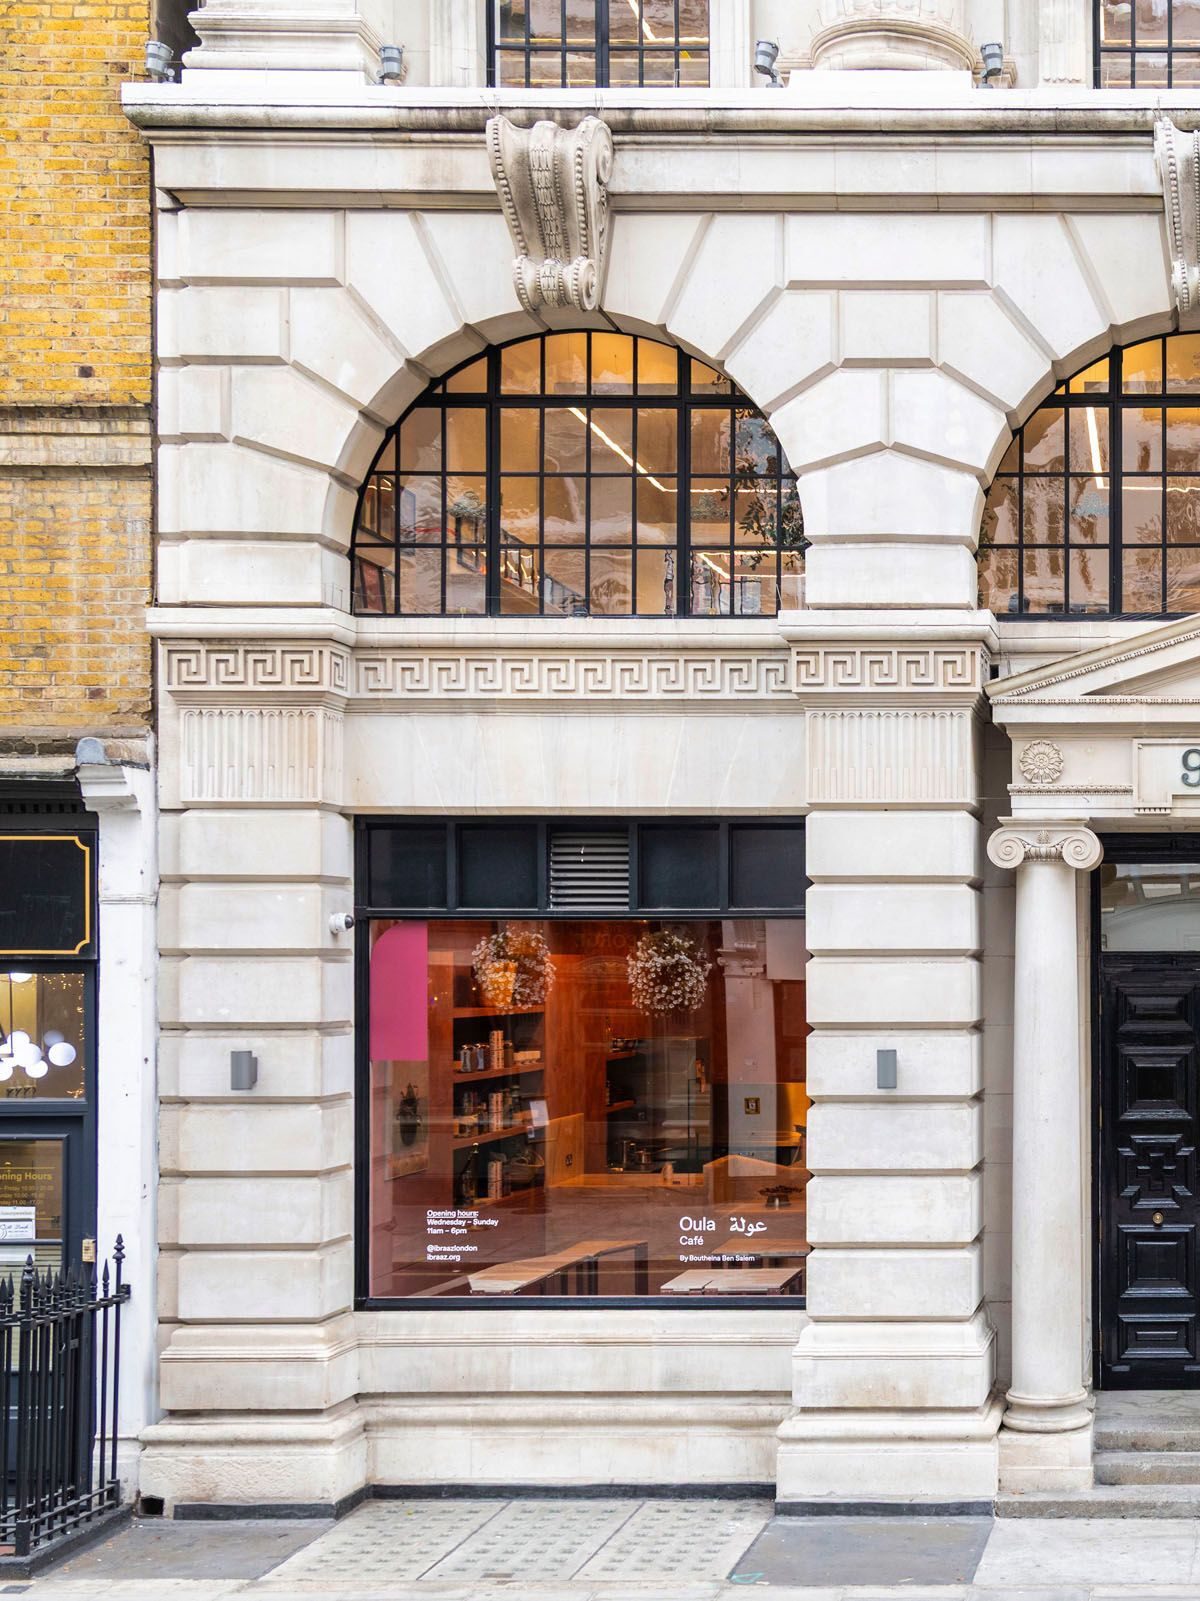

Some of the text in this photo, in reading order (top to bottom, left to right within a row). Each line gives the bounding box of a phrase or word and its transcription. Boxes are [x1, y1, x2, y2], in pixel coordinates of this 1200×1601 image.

[25, 1172, 53, 1180] Hours
[427, 1210, 456, 1218] Opening
[427, 1219, 466, 1227] Wednesday
[679, 1216, 716, 1231] Oula
[729, 1216, 768, 1237] عولة
[450, 1227, 467, 1235] 6pm
[679, 1235, 704, 1245] Café
[427, 1253, 461, 1261] ibraaz.org
[722, 1254, 735, 1262] Ben
[735, 1254, 756, 1262] Salem
